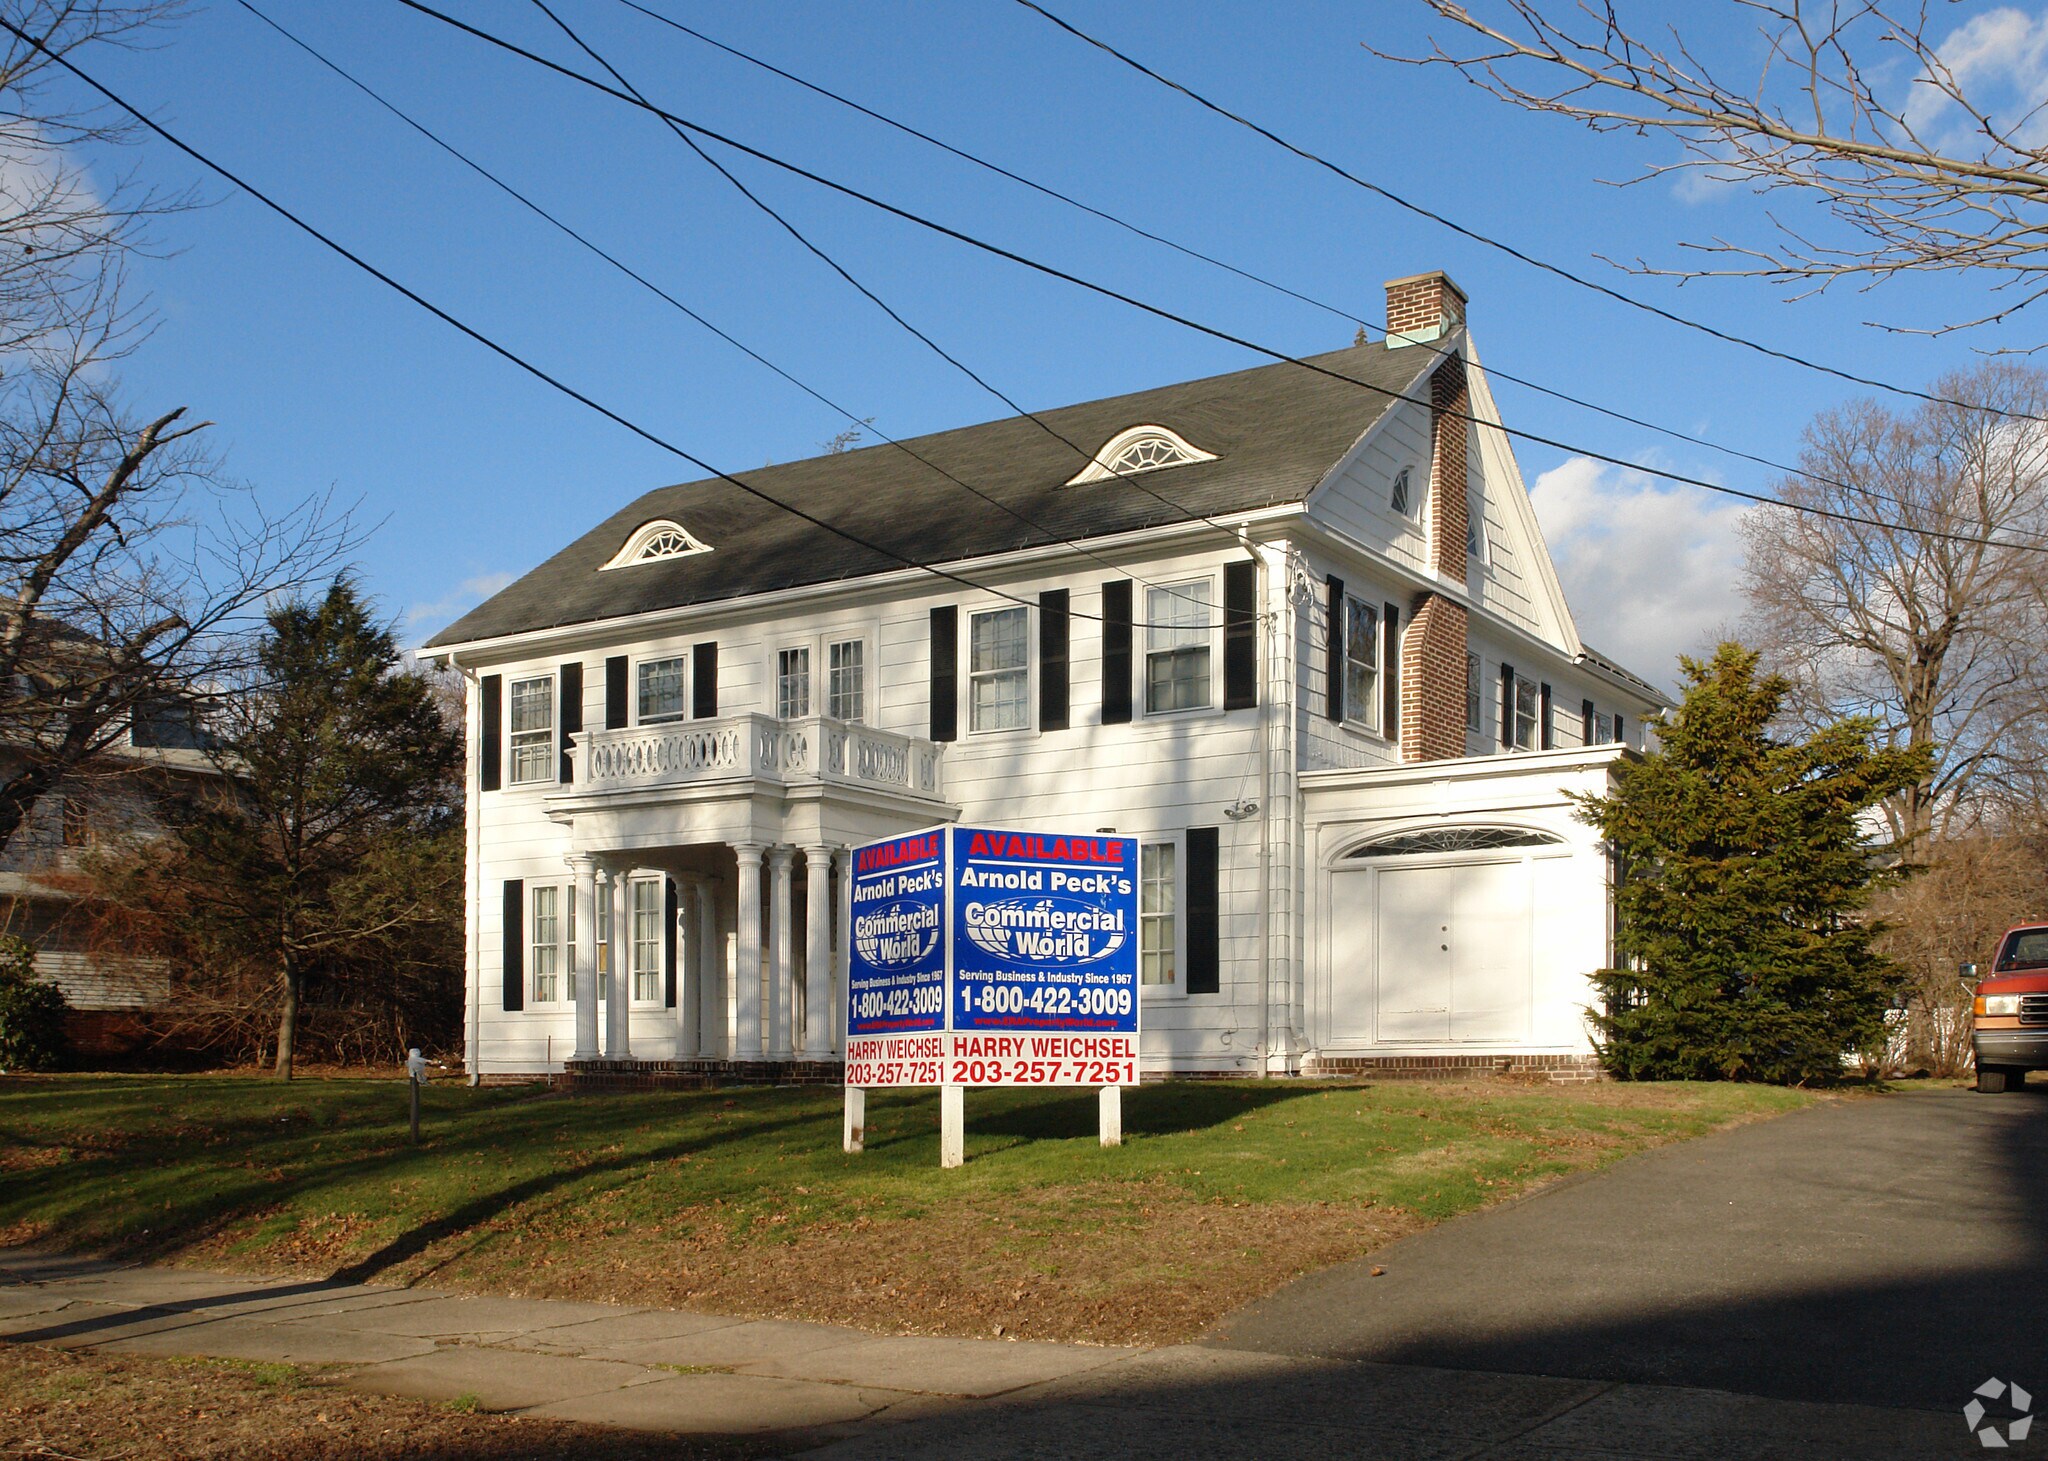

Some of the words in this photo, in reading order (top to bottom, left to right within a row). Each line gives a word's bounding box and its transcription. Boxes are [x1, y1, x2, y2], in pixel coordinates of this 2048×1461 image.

[858, 835, 938, 871] AVAILABLE
[969, 833, 1124, 863] AVAILABLE
[854, 877, 894, 903] Arnold
[898, 869, 943, 895] Peck's
[960, 867, 1042, 890] Arnold
[1051, 871, 1132, 895] Peck's
[855, 904, 938, 938] Commercial
[965, 902, 1124, 931] Commercial
[880, 934, 920, 960] World
[1015, 931, 1090, 957] World
[851, 980, 868, 990] Serving
[869, 977, 890, 987] Business
[896, 974, 916, 985] Industry
[917, 972, 930, 983] Since
[931, 970, 943, 981] 1967
[959, 969, 993, 983] Serving
[995, 971, 1036, 983] Business
[1038, 972, 1045, 982] &
[1047, 972, 1083, 985] Industry
[1085, 973, 1109, 984] Since
[1111, 974, 1132, 984] 1967
[851, 985, 943, 1019] 1-800-422-3009
[961, 985, 1132, 1015] 1-800-422-3009
[848, 1040, 884, 1060] HARRY
[886, 1037, 945, 1059] WEICHSEL
[954, 1037, 1025, 1058] HARRY
[1032, 1037, 1136, 1058] WEICHSEL
[847, 1061, 944, 1084] 203-257-7251
[952, 1061, 1133, 1083] 203-257-7251
